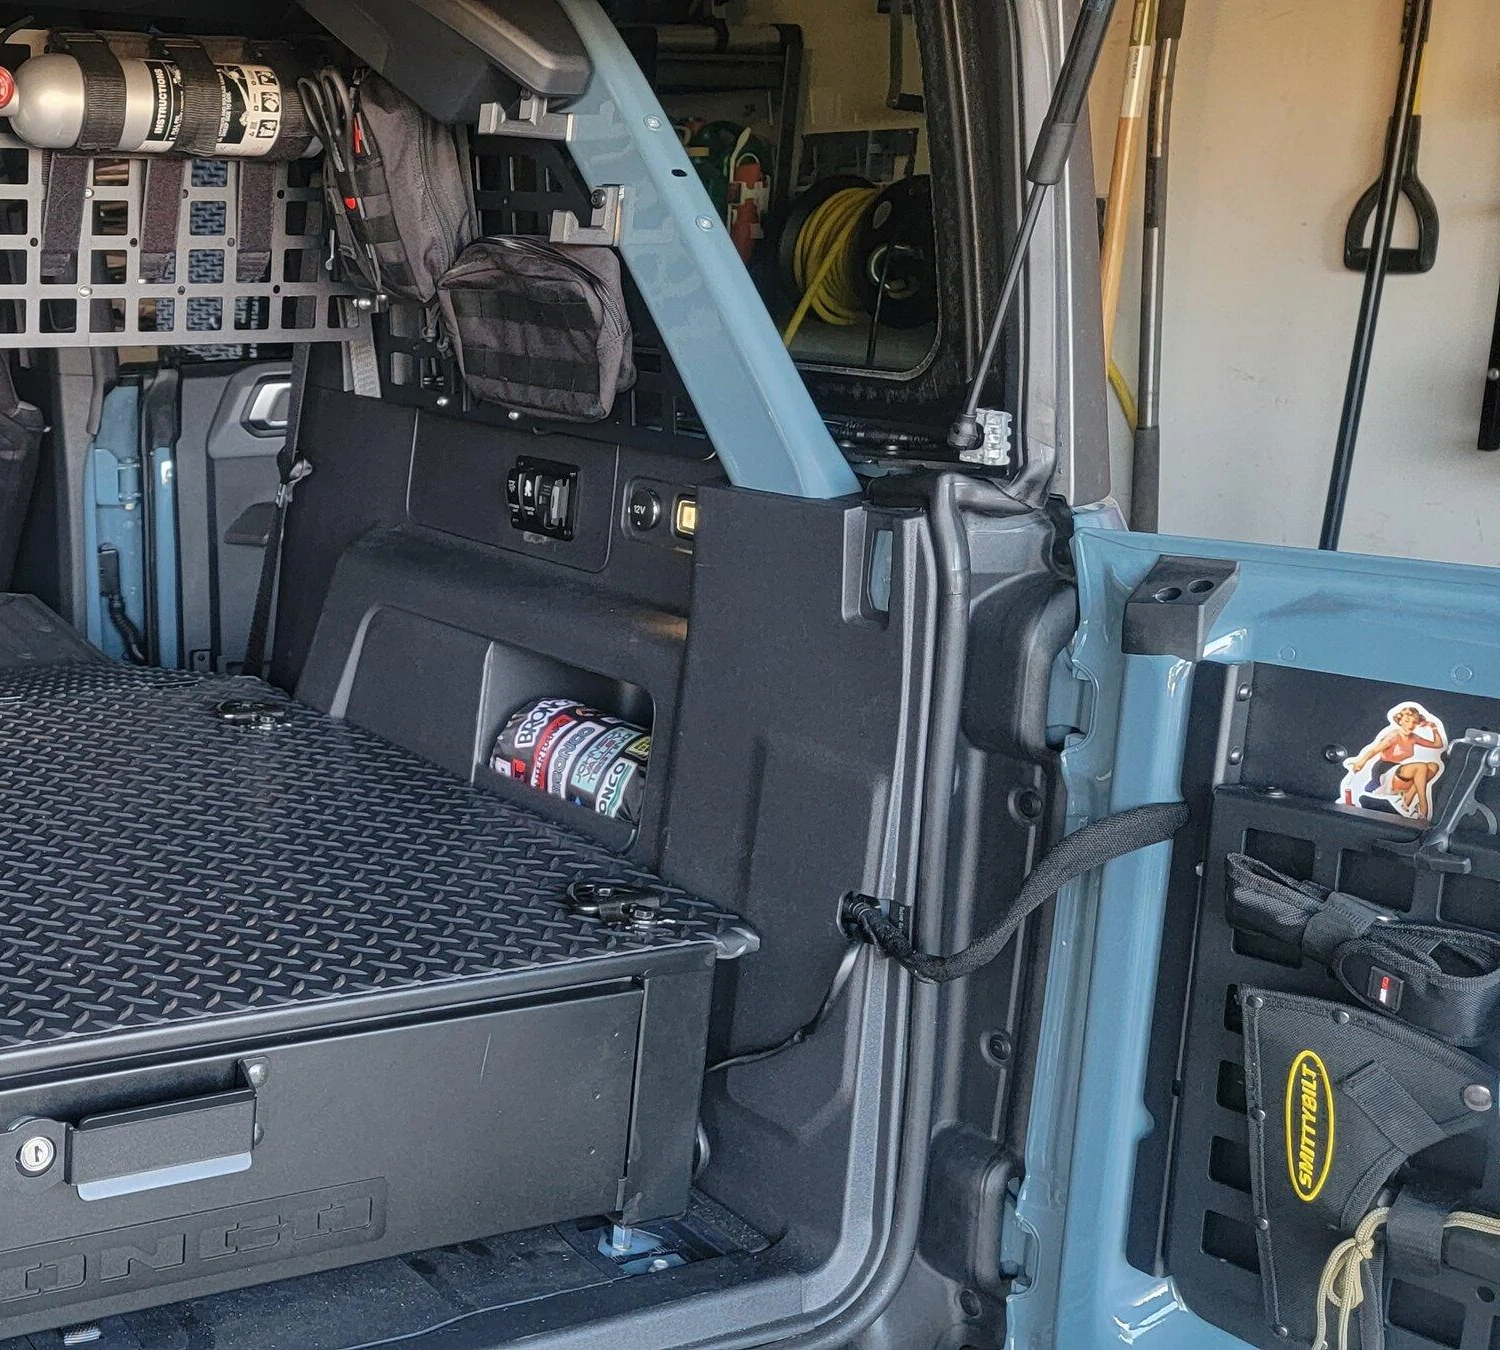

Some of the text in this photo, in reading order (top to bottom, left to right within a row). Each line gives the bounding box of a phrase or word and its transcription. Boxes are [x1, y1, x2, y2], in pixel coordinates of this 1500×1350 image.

[153, 68, 168, 134] INSTRUCTIONS
[633, 504, 646, 515] 12V
[516, 700, 571, 745] BRONC
[581, 732, 622, 777] VALLEY
[598, 762, 626, 815] ONCO
[1298, 1062, 1318, 1189] SMITTYBILT
